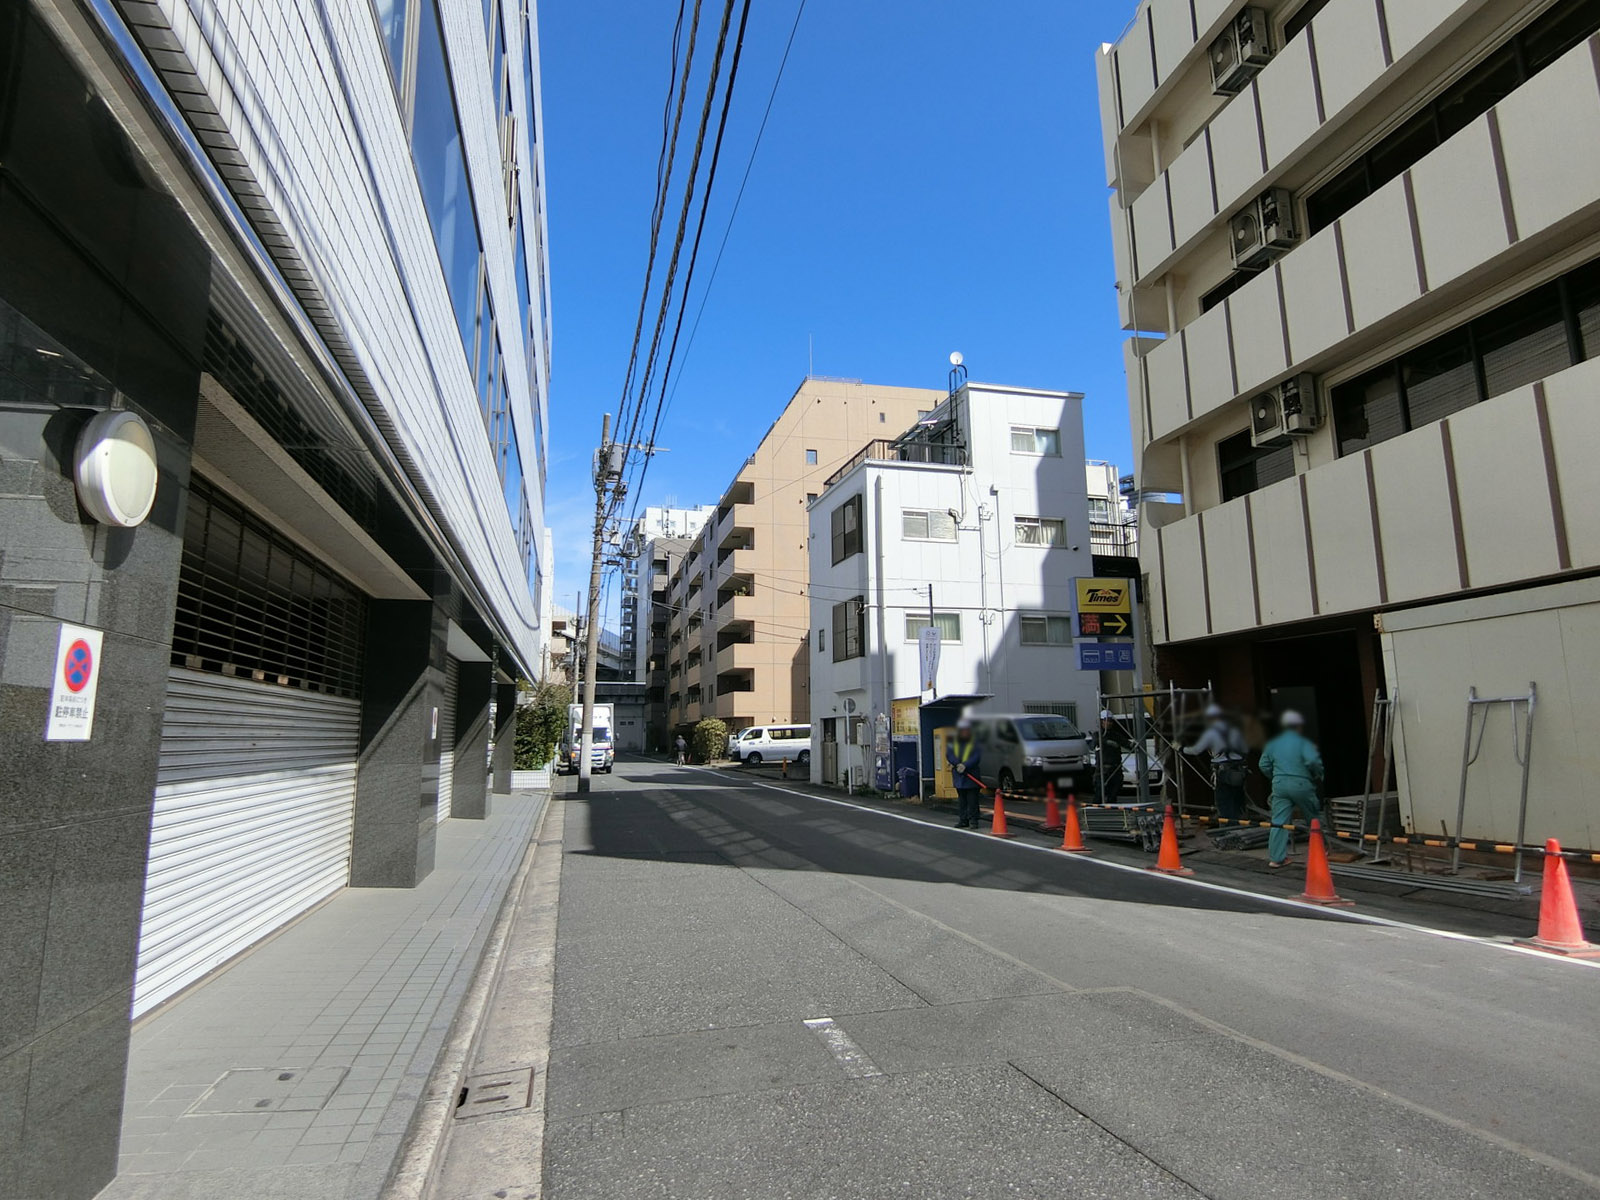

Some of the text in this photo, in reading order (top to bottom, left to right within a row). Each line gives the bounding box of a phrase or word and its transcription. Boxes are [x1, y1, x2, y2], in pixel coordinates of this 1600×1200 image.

[1086, 589, 1122, 603] Times
[1081, 614, 1101, 634] 満
[55, 706, 88, 718] 駐停車禁止
